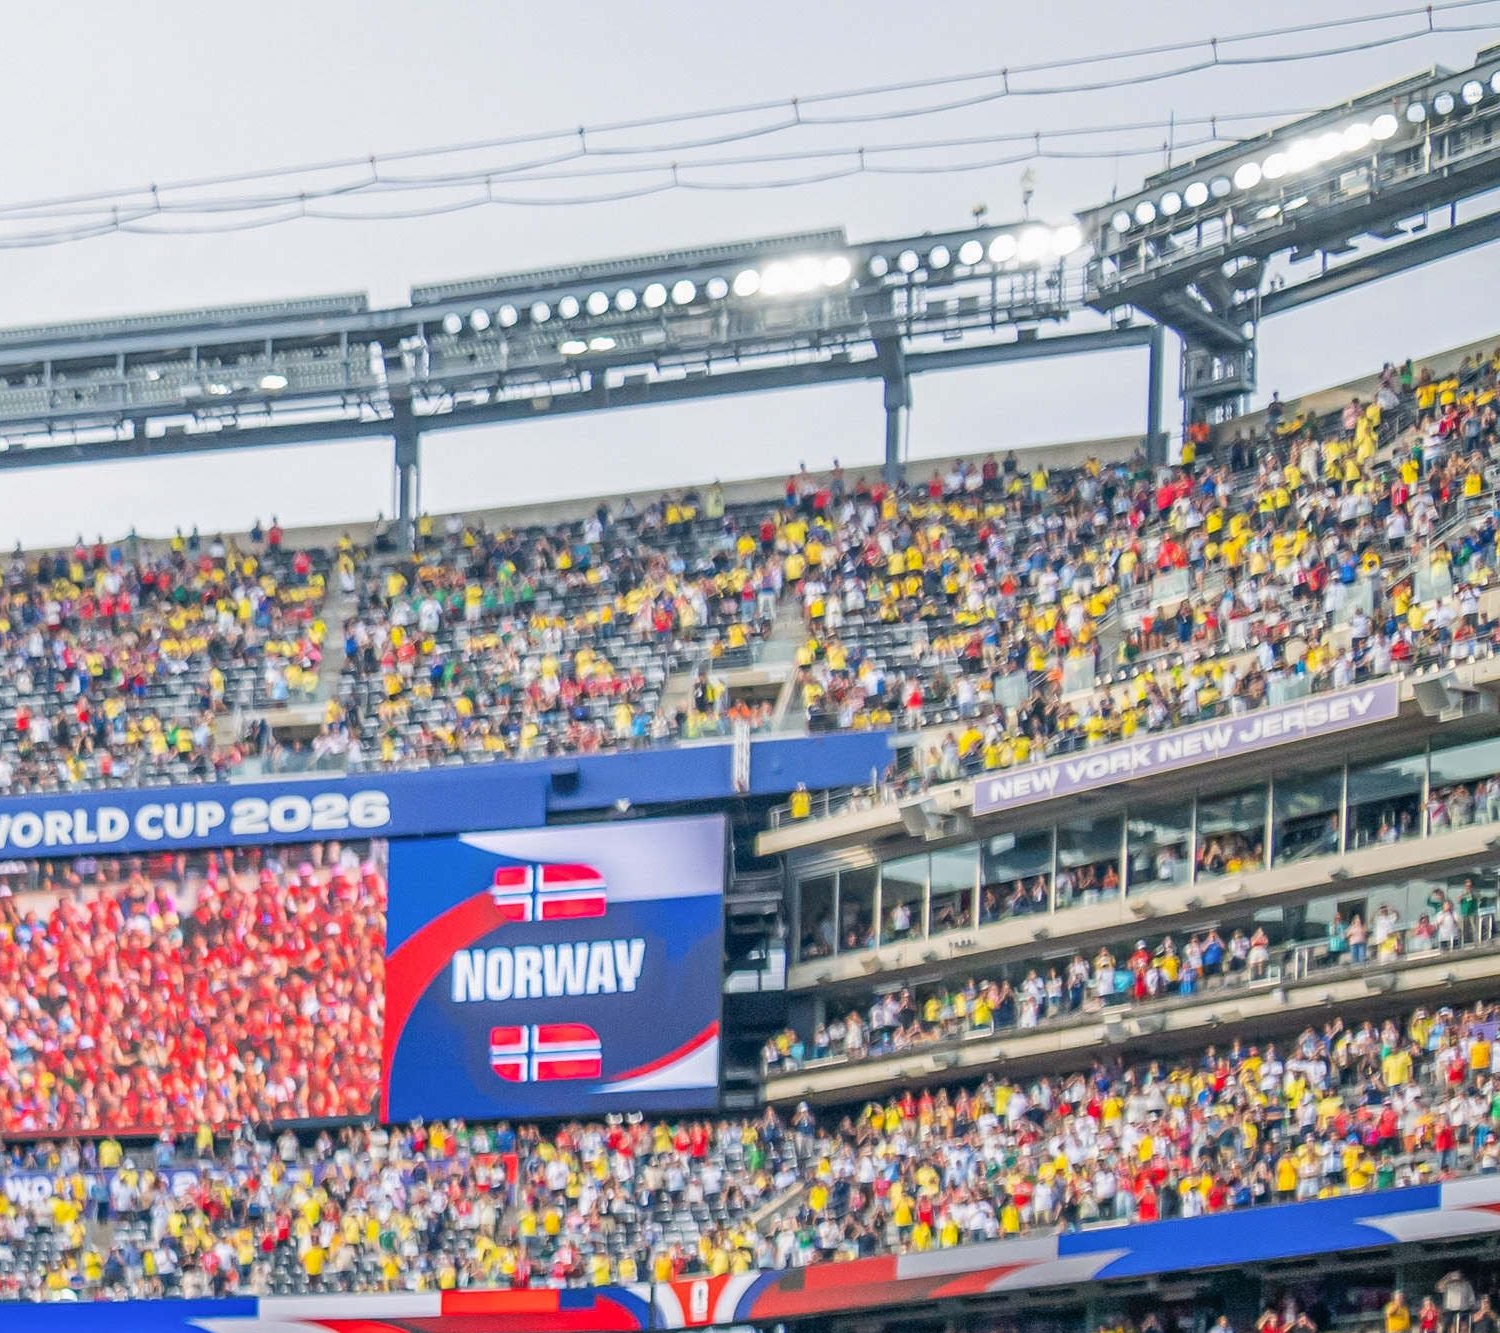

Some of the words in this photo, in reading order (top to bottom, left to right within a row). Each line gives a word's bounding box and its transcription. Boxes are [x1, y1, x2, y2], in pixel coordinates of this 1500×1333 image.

[990, 769, 1060, 803] NEW
[1065, 745, 1153, 782] YORK
[1157, 724, 1234, 762] NEW
[1238, 689, 1377, 744] JERSEY
[134, 799, 227, 841] CUP
[229, 789, 393, 837] 2026
[452, 937, 646, 1003] NORWAY
